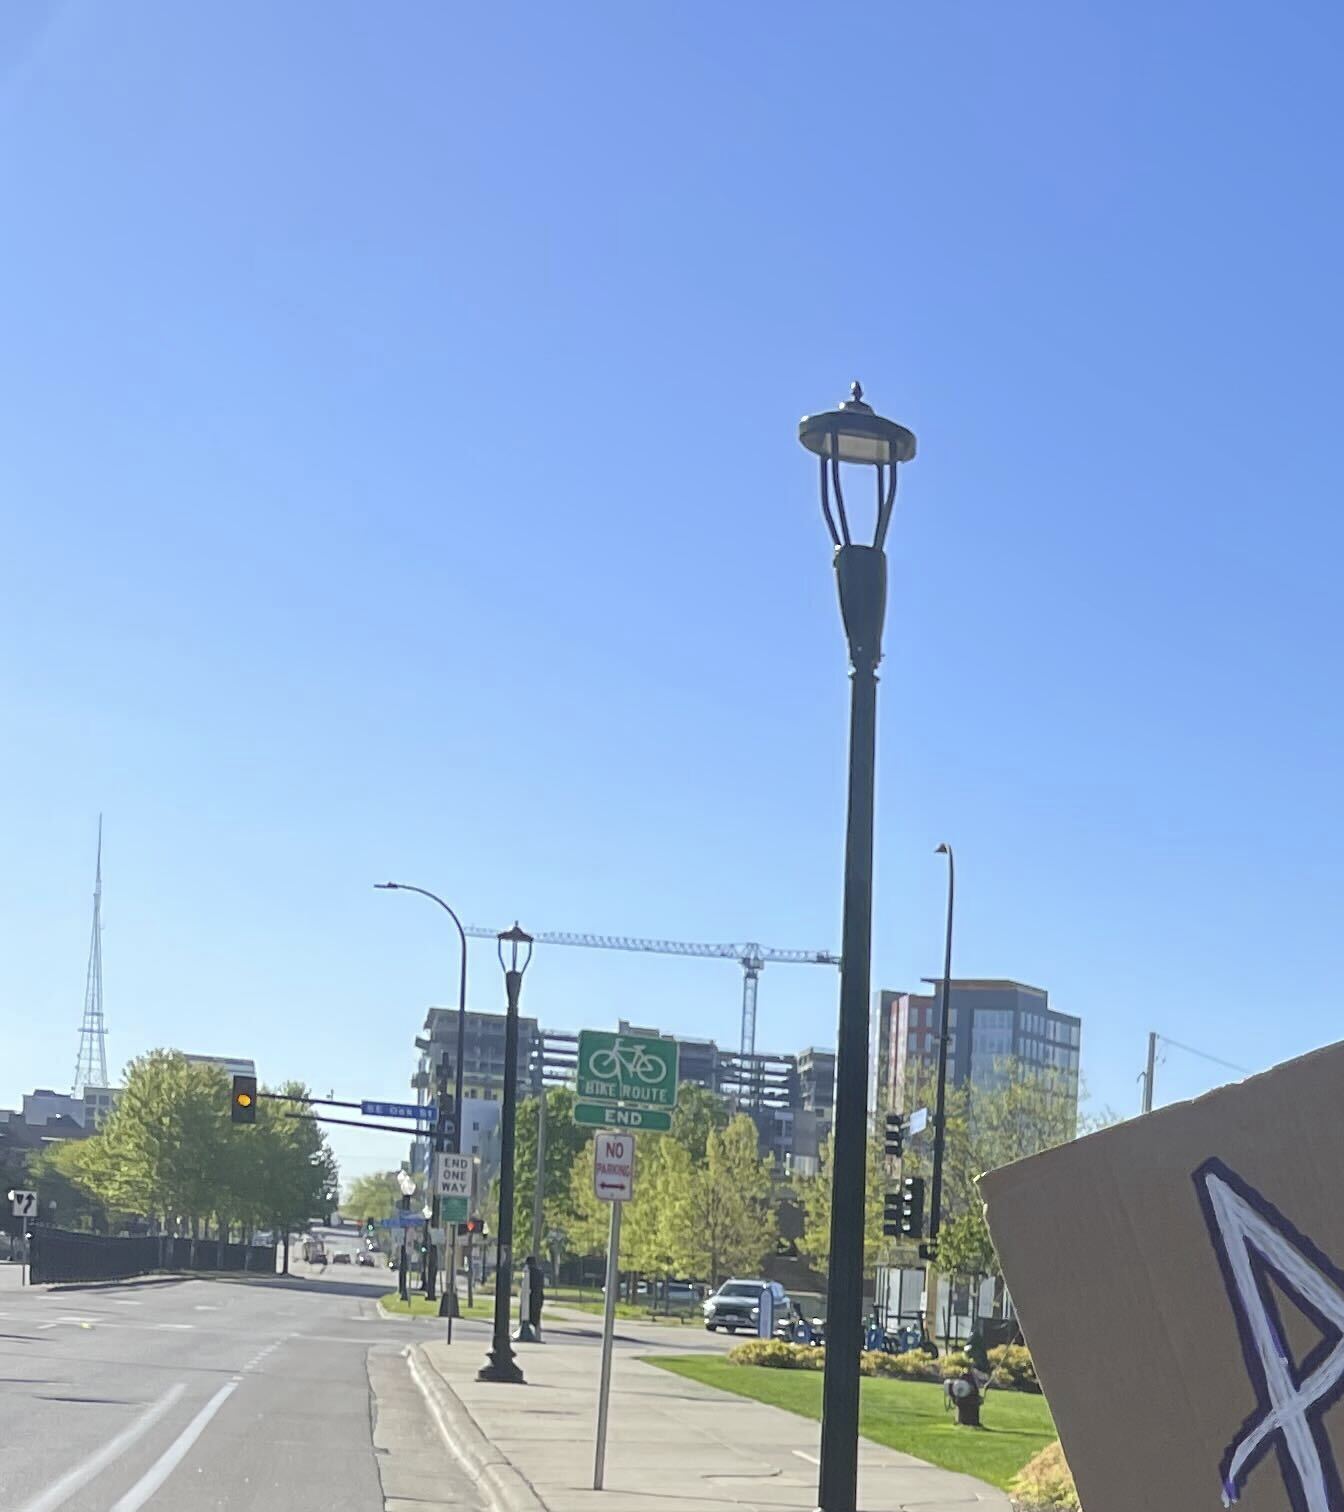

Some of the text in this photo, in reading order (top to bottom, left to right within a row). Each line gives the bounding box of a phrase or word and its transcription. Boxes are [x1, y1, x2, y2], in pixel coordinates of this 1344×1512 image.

[586, 1080, 666, 1103] BIKE ROUTE
[605, 1110, 641, 1125] END
[607, 1143, 624, 1158] NO
[444, 1158, 468, 1169] END
[597, 1163, 633, 1177] PARKING
[443, 1169, 467, 1180] ONE
[442, 1182, 467, 1193] WAY
